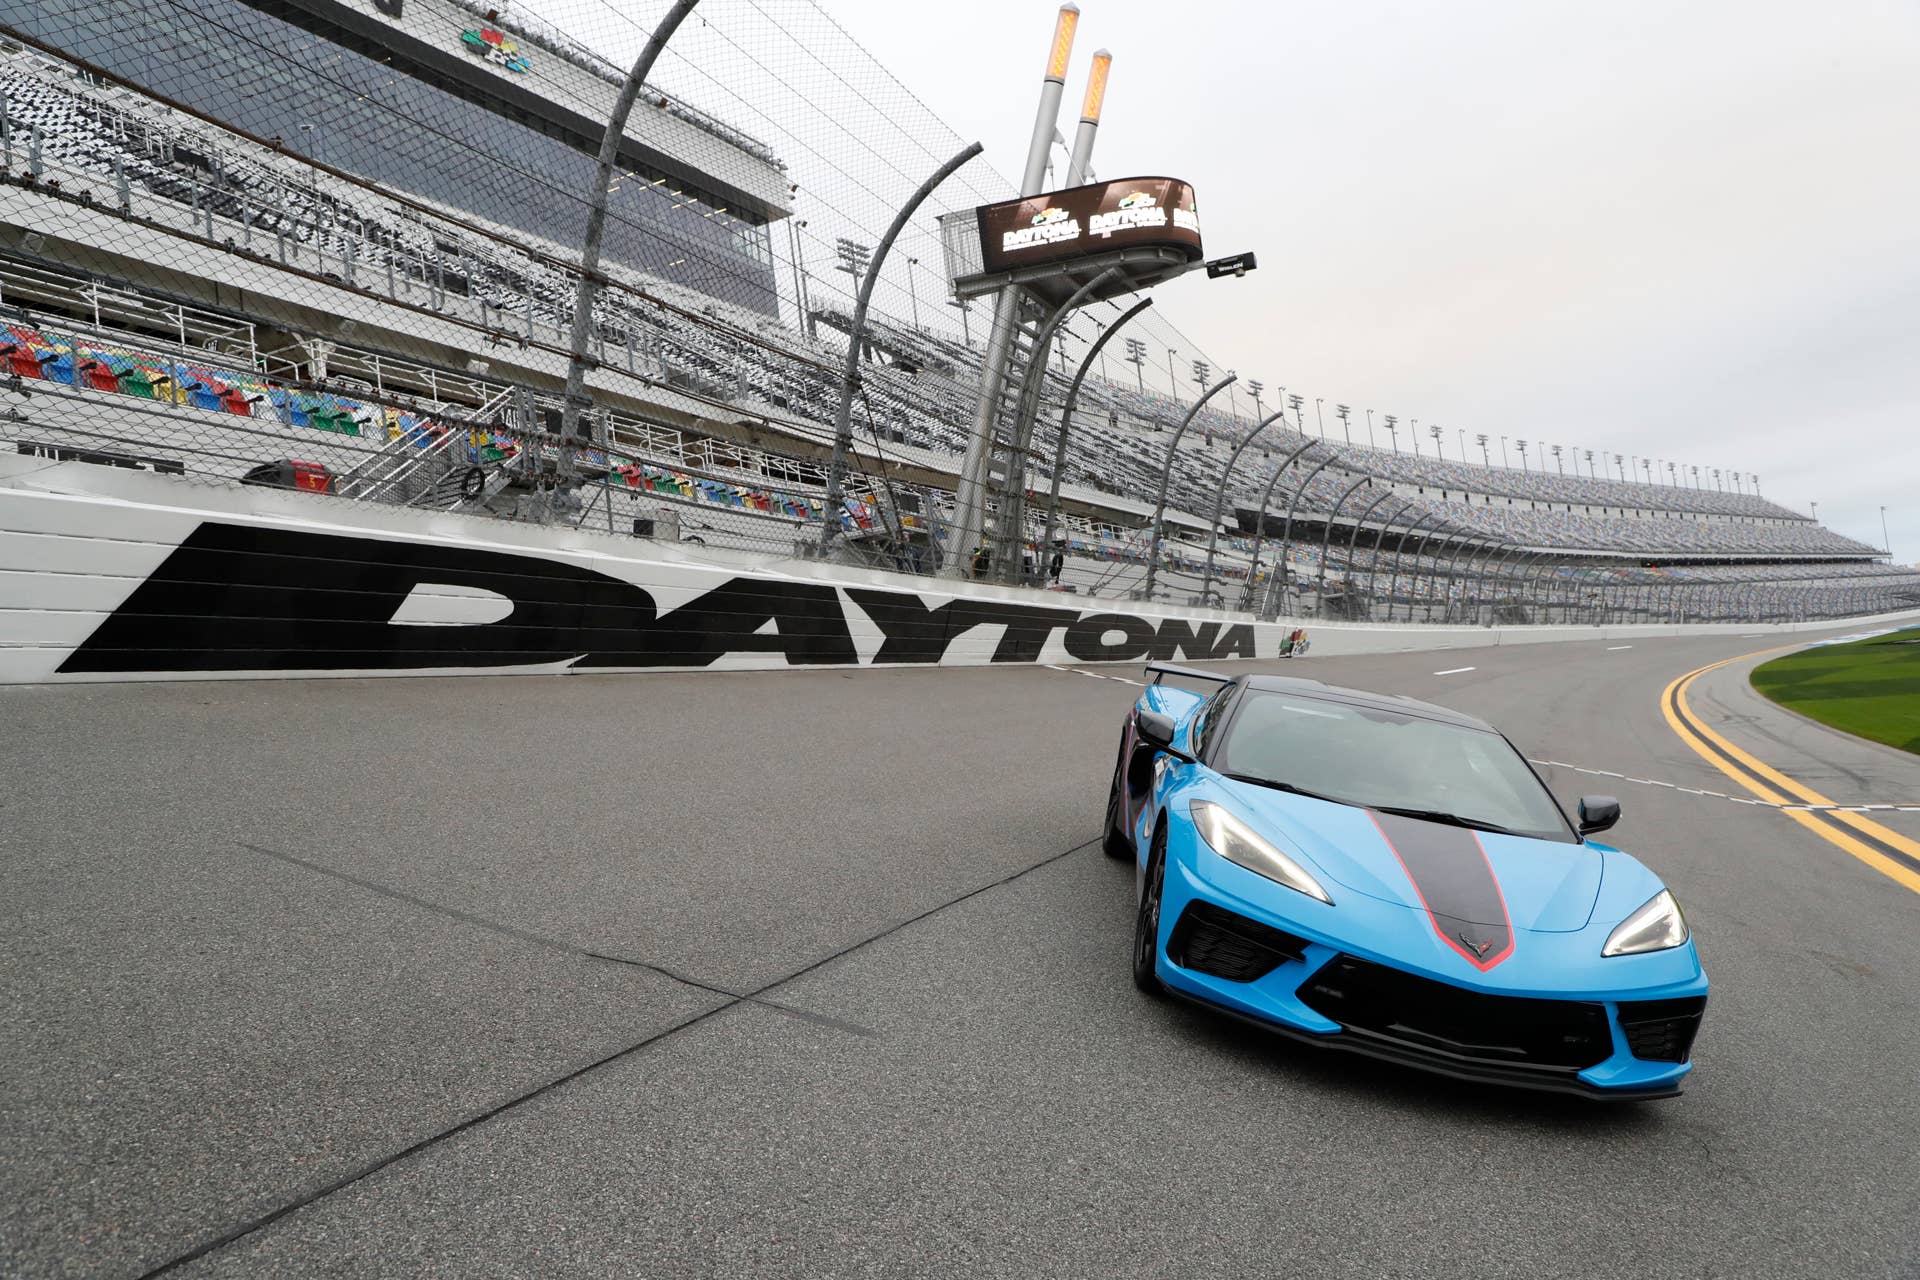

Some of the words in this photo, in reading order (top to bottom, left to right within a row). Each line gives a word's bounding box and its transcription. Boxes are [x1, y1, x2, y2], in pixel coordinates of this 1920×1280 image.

[1003, 219, 1079, 246] DAYTONA
[1090, 207, 1166, 231] DAYTONA
[55, 522, 1256, 673] DAYTONA
